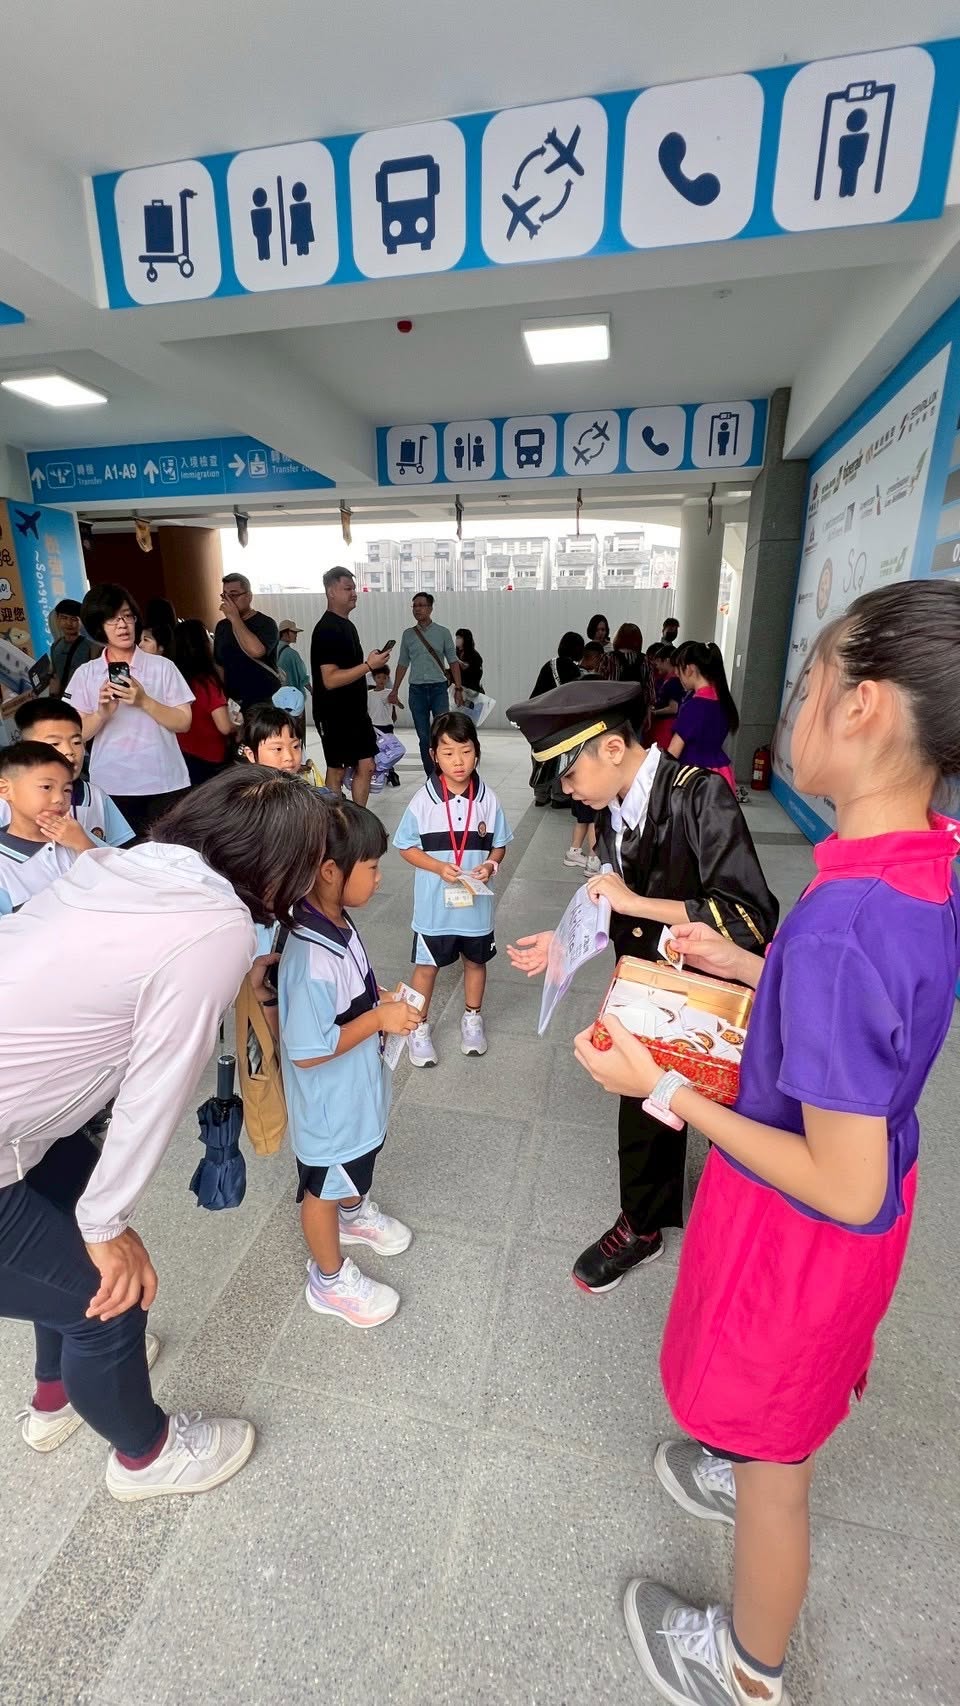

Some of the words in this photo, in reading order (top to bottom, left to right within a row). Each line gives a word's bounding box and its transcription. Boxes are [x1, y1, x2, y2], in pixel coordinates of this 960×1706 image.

[104, 463, 137, 480] A1-A9
[272, 464, 299, 473] Transfer
[181, 471, 220, 480] Immigration
[78, 477, 102, 485] Transfer
[0, 607, 25, 622] 迎您
